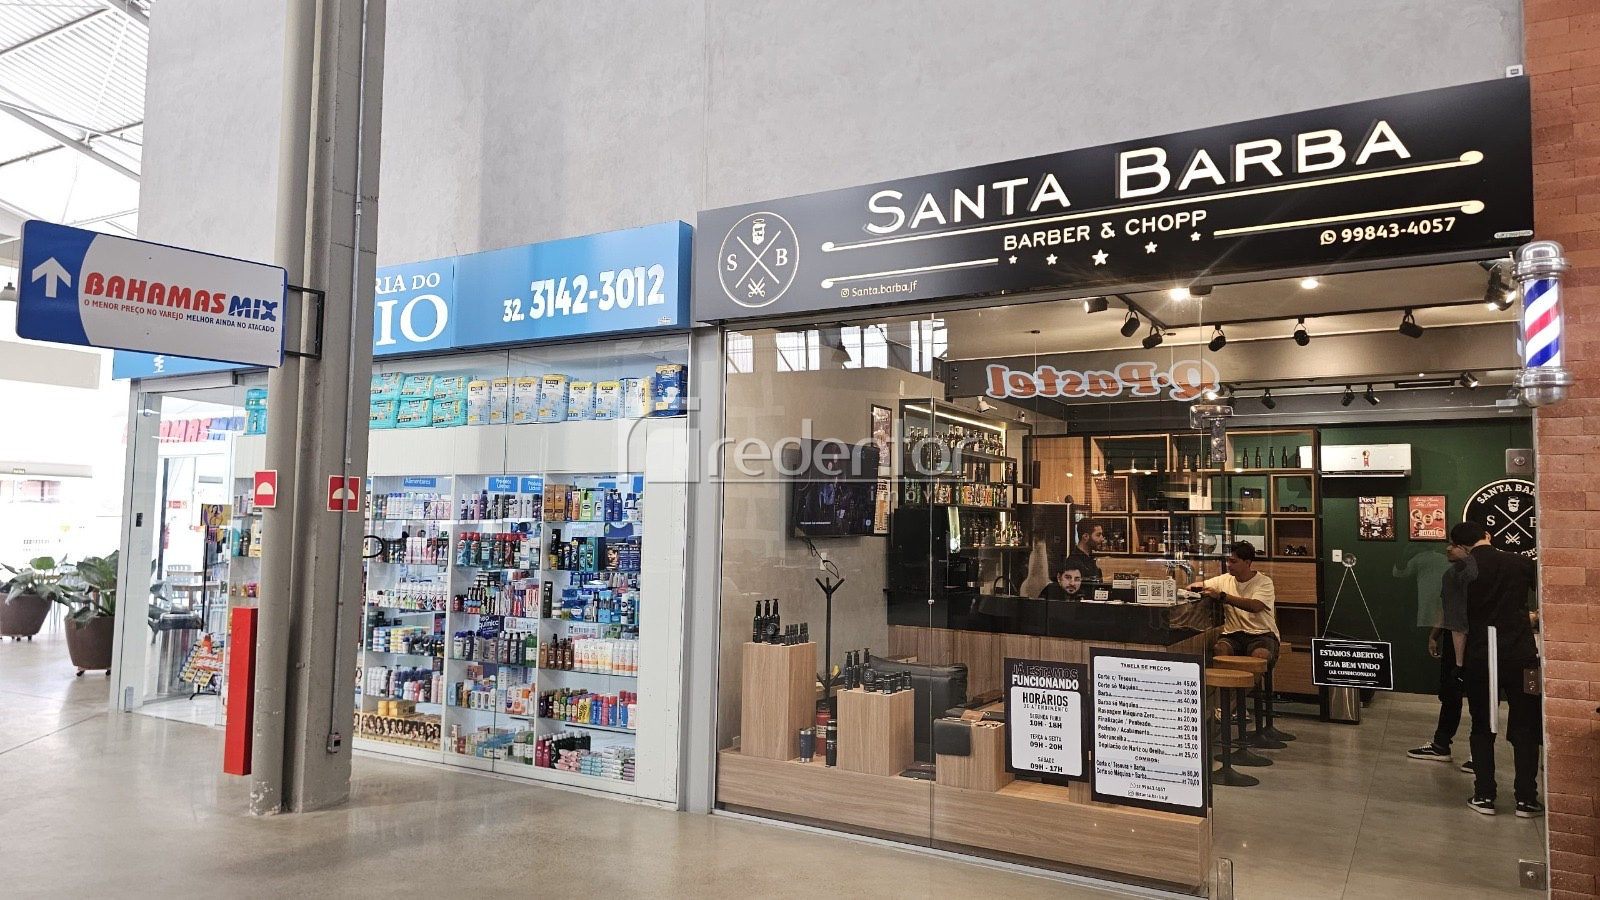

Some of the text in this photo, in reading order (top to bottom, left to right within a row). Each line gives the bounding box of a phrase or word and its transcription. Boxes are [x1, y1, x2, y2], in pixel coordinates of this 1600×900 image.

[866, 119, 1411, 234] SANTA BARBA
[1004, 209, 1207, 251] BARBER & CHOPP
[1341, 217, 1456, 243] 99843-4057
[726, 248, 789, 272] S B
[411, 272, 440, 290] DO
[851, 280, 918, 297] Santa.barba.jf
[84, 272, 279, 322] BAHAMAS MIX
[529, 263, 665, 320] 3142-3012
[84, 298, 275, 333] O MENOR PREÇO NO VAREJO MELHOR AINDA NO ATACADO
[1477, 484, 1513, 504] SANTA
[1486, 515, 1496, 526] S
[1319, 649, 1384, 660] ESTAMOS ABERTOS
[1013, 662, 1079, 680] JÁ ESTAMOS
[1323, 660, 1380, 670] SEJA BEM VINDO
[1012, 674, 1079, 690] FUNCIONANDO
[1022, 691, 1068, 707] HORÁRIOS
[1030, 741, 1043, 749] 09H
